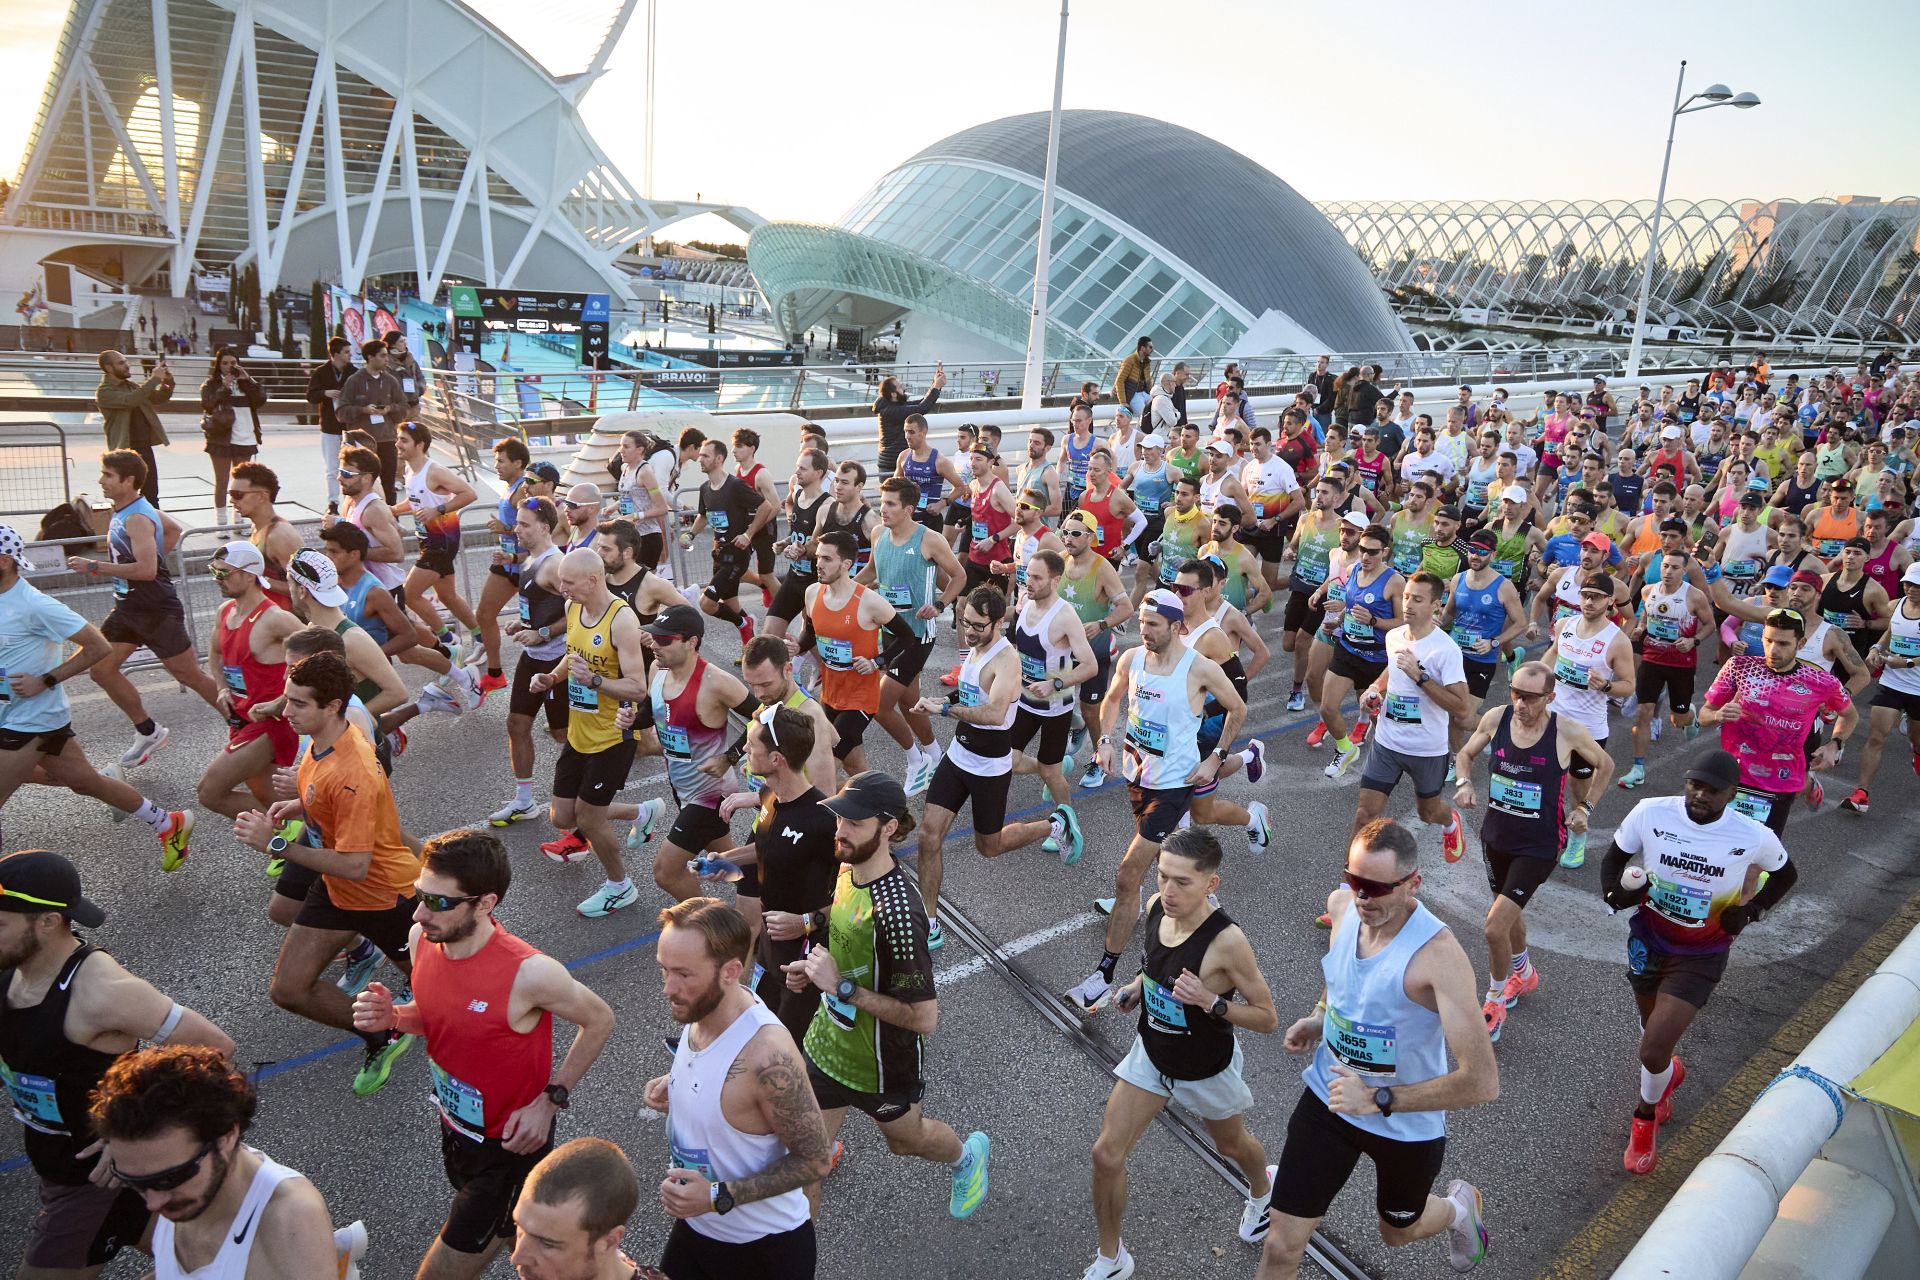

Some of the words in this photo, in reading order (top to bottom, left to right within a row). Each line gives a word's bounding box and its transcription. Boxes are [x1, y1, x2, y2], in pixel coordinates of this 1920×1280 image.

[657, 372, 706, 384] ¡BRAVO!
[573, 645, 608, 667] VALLEY
[1561, 642, 1594, 659] POLSKA
[1135, 688, 1161, 699] CAMPUS
[1135, 692, 1151, 701] CLUB
[1764, 715, 1802, 730] TIMING
[1504, 787, 1523, 799] 3833
[1736, 801, 1754, 811] 3494
[1680, 851, 1708, 863] VALENCIA
[1659, 853, 1726, 878] MARATHON
[1663, 891, 1688, 906] 1923
[1683, 908, 1692, 916] M
[1338, 1030, 1367, 1049] 3655
[1335, 1040, 1373, 1061] THOMAS
